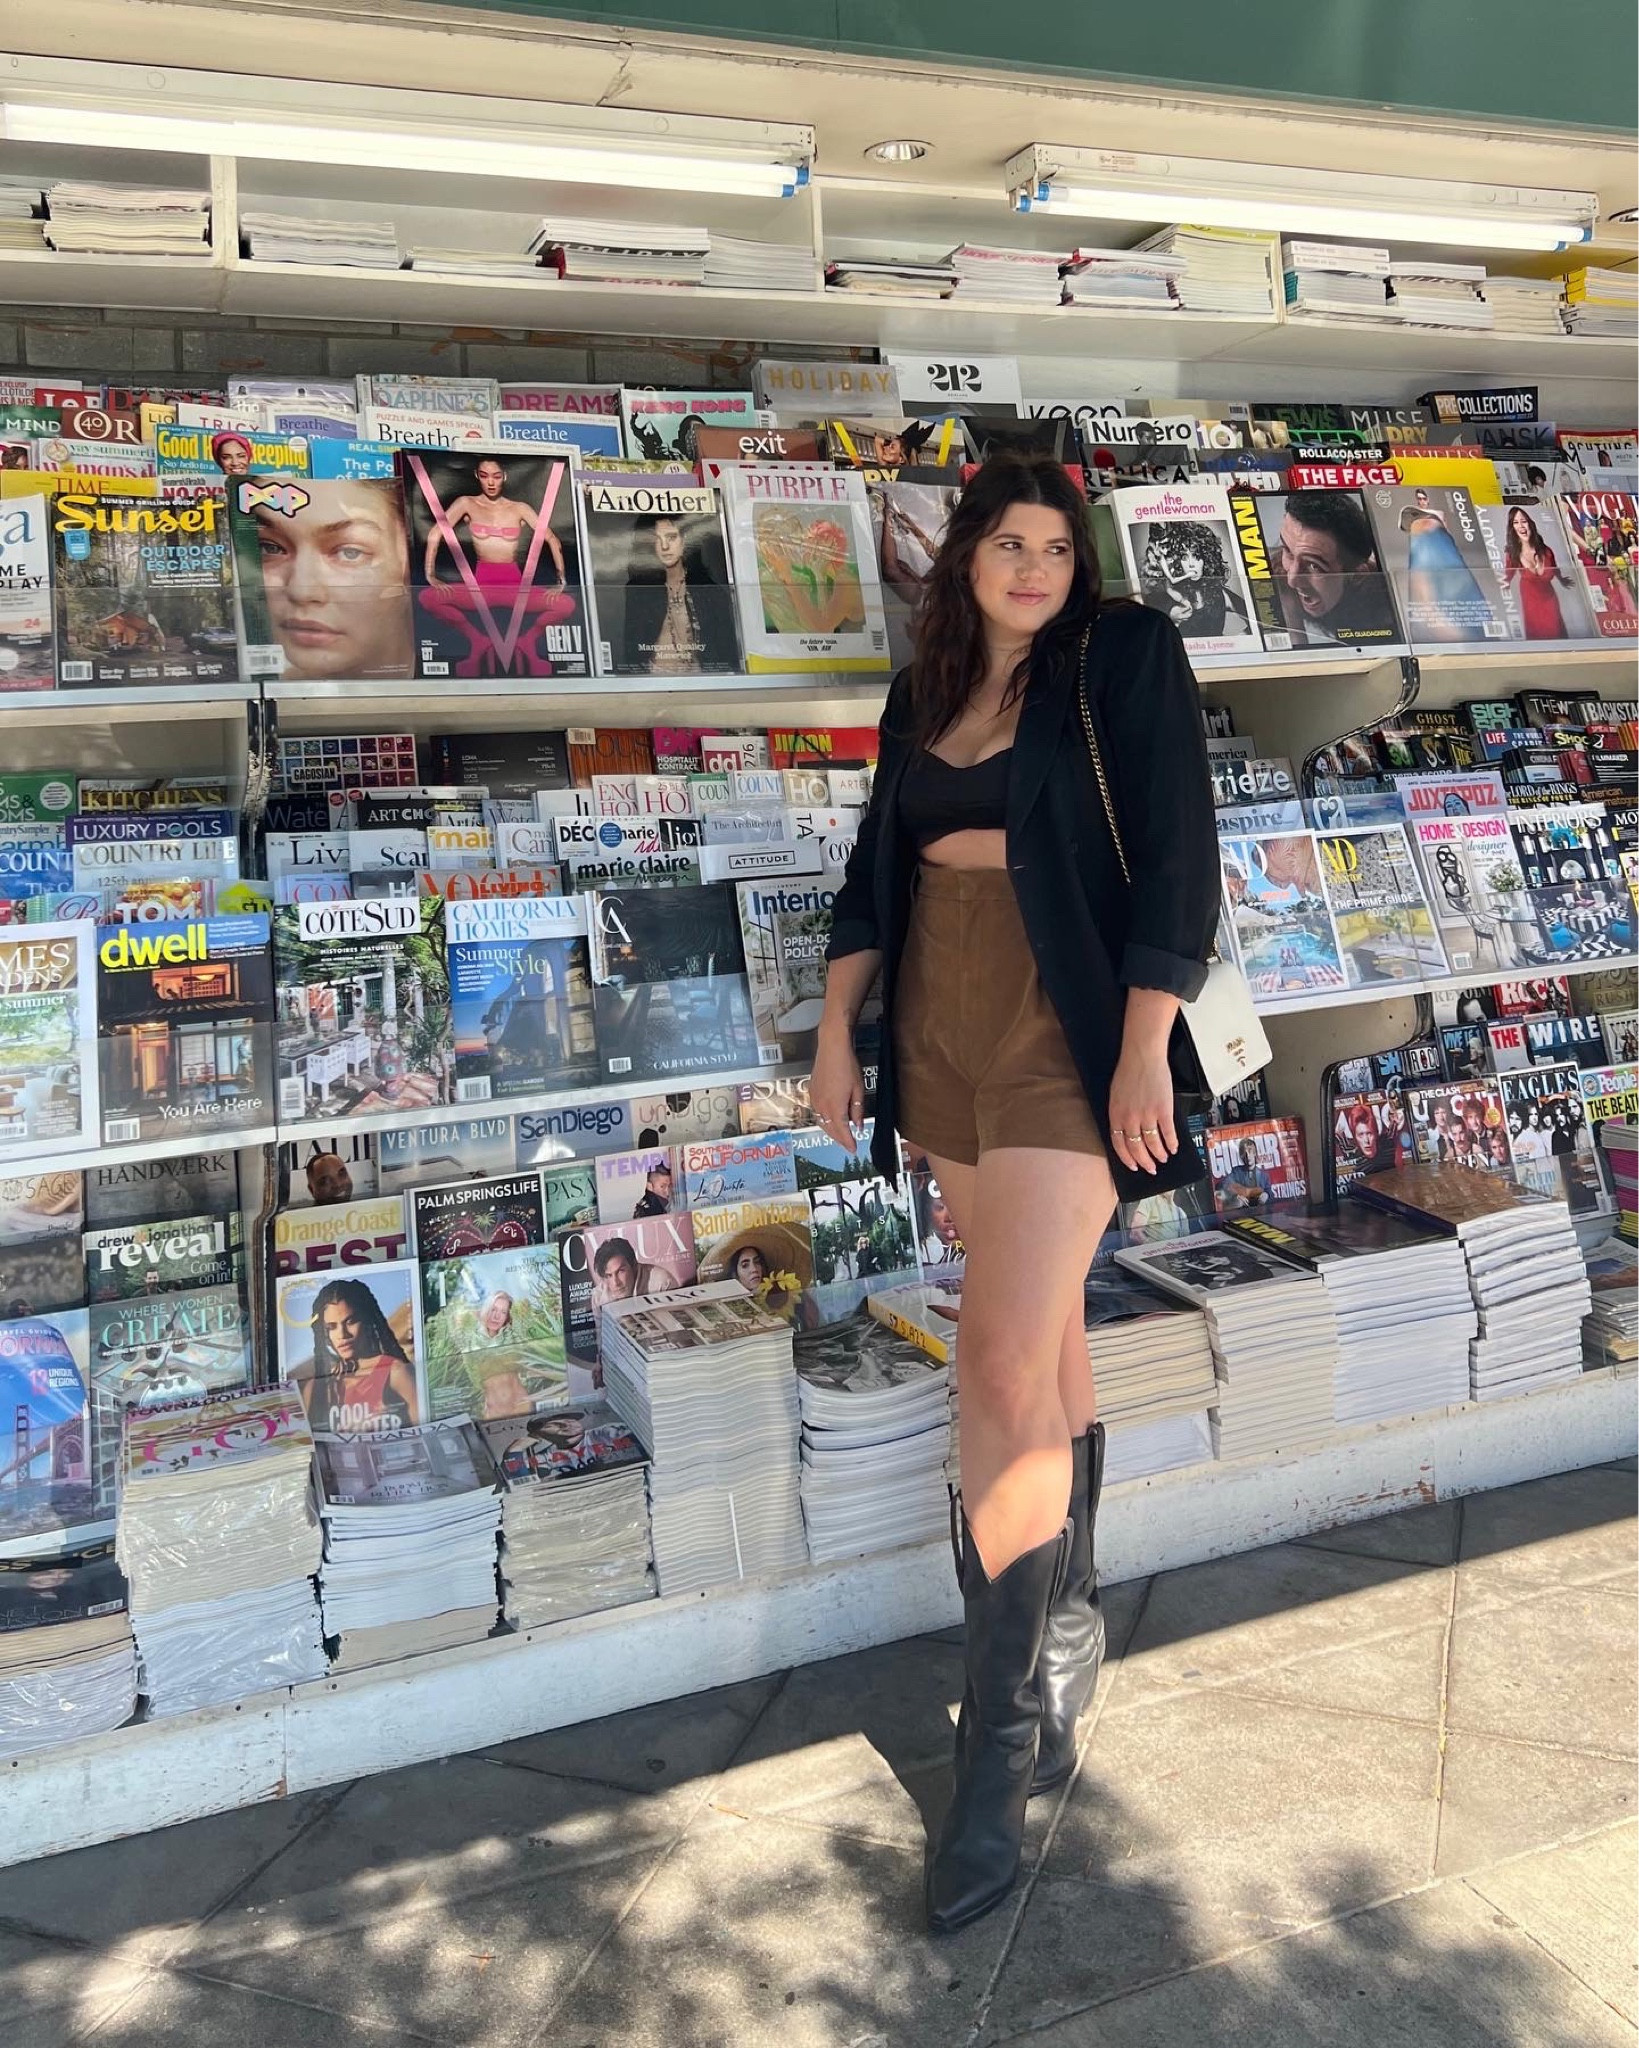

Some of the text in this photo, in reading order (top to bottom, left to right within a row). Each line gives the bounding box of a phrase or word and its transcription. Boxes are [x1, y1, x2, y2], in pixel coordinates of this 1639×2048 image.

[768, 367, 891, 393] HOLIDAY
[926, 363, 983, 393] 212
[378, 387, 488, 413] DAPHNE'S
[505, 393, 618, 415] DREAMS
[1457, 393, 1534, 415] COLLECTIONS
[6, 419, 61, 433] MIND
[279, 418, 329, 432] Breathe
[376, 413, 405, 422] PUZZLE
[407, 416, 424, 424] AND
[426, 418, 455, 428] GAMES
[502, 424, 568, 441] Breathe
[1091, 421, 1192, 443] Numéro
[1387, 426, 1428, 445] DRY
[158, 431, 198, 461] Good
[348, 443, 374, 453] REAL
[739, 431, 788, 455] exit
[1299, 448, 1383, 460] ROLLACOASTER
[343, 458, 371, 472] The
[55, 477, 110, 495] TIME
[746, 474, 846, 500] PURPLE
[1299, 468, 1397, 486] THE FACE
[101, 497, 135, 505] SUMMER
[596, 488, 708, 513] AnOther
[1164, 492, 1183, 506] the
[55, 496, 225, 534] Sunset
[1134, 502, 1216, 520] gentlewoman
[1452, 491, 1475, 543] double
[1231, 500, 1272, 581] MAN
[141, 545, 226, 559] OUTDOOR
[146, 559, 222, 573] ESCAPES
[406, 454, 566, 674] V
[24, 617, 41, 630] 24
[1416, 713, 1456, 725] GHOST
[1486, 732, 1507, 744] LIFE
[294, 768, 336, 781] GAGOSIAN
[86, 787, 223, 810] KITCHENS
[367, 808, 399, 823] ART
[1216, 808, 1283, 834] aspire
[1514, 812, 1602, 834] INTERIORS
[73, 820, 222, 841] LUXURY POOLS
[1419, 820, 1508, 841] HOME DESIGN
[80, 842, 185, 866] COUNTRY
[1467, 840, 1508, 852] designer
[578, 855, 691, 879] marie claire
[734, 853, 789, 867] ATTITUDE
[452, 901, 578, 922] CALIFORNIA
[1335, 893, 1414, 909] THE PRIME GUIDE
[454, 920, 529, 941] HOMES
[100, 923, 208, 969] dwell
[320, 946, 358, 956] HISTOIRES
[455, 947, 524, 962] Summer
[785, 945, 828, 959] POLICY
[496, 954, 545, 976] Style
[5, 994, 66, 1010] summer
[1491, 1015, 1601, 1049] THE WIRE
[1420, 1085, 1461, 1099] THE CLASH
[1502, 1070, 1579, 1101] EAGLES
[1599, 1073, 1638, 1093] People
[158, 1096, 263, 1119] You Are Here
[1587, 1100, 1609, 1119] THE
[520, 1105, 625, 1141] SanDiego
[386, 1119, 507, 1151] VENTURA BLVD
[792, 1134, 822, 1149] PALM
[688, 1143, 734, 1156] SOUTHERN
[688, 1141, 790, 1173] CALIFORNIA
[97, 1154, 228, 1187] HANDVÆRK
[418, 1180, 540, 1210] PALM SPRINGS LIFE
[693, 1179, 709, 1202] La
[1270, 1180, 1307, 1199] STRINGS
[693, 1209, 738, 1237] Santa
[1229, 1217, 1297, 1244] MAN
[97, 1233, 136, 1249] drew
[146, 1223, 216, 1247] jonathan
[101, 1221, 226, 1272] reveal
[190, 1259, 227, 1275] Come
[199, 1268, 231, 1285] on in!
[568, 1282, 593, 1292] LUXURY
[119, 1294, 223, 1320] WHERE WOMEN
[102, 1303, 239, 1349] CREATE
[330, 1422, 452, 1445] VERANDA
